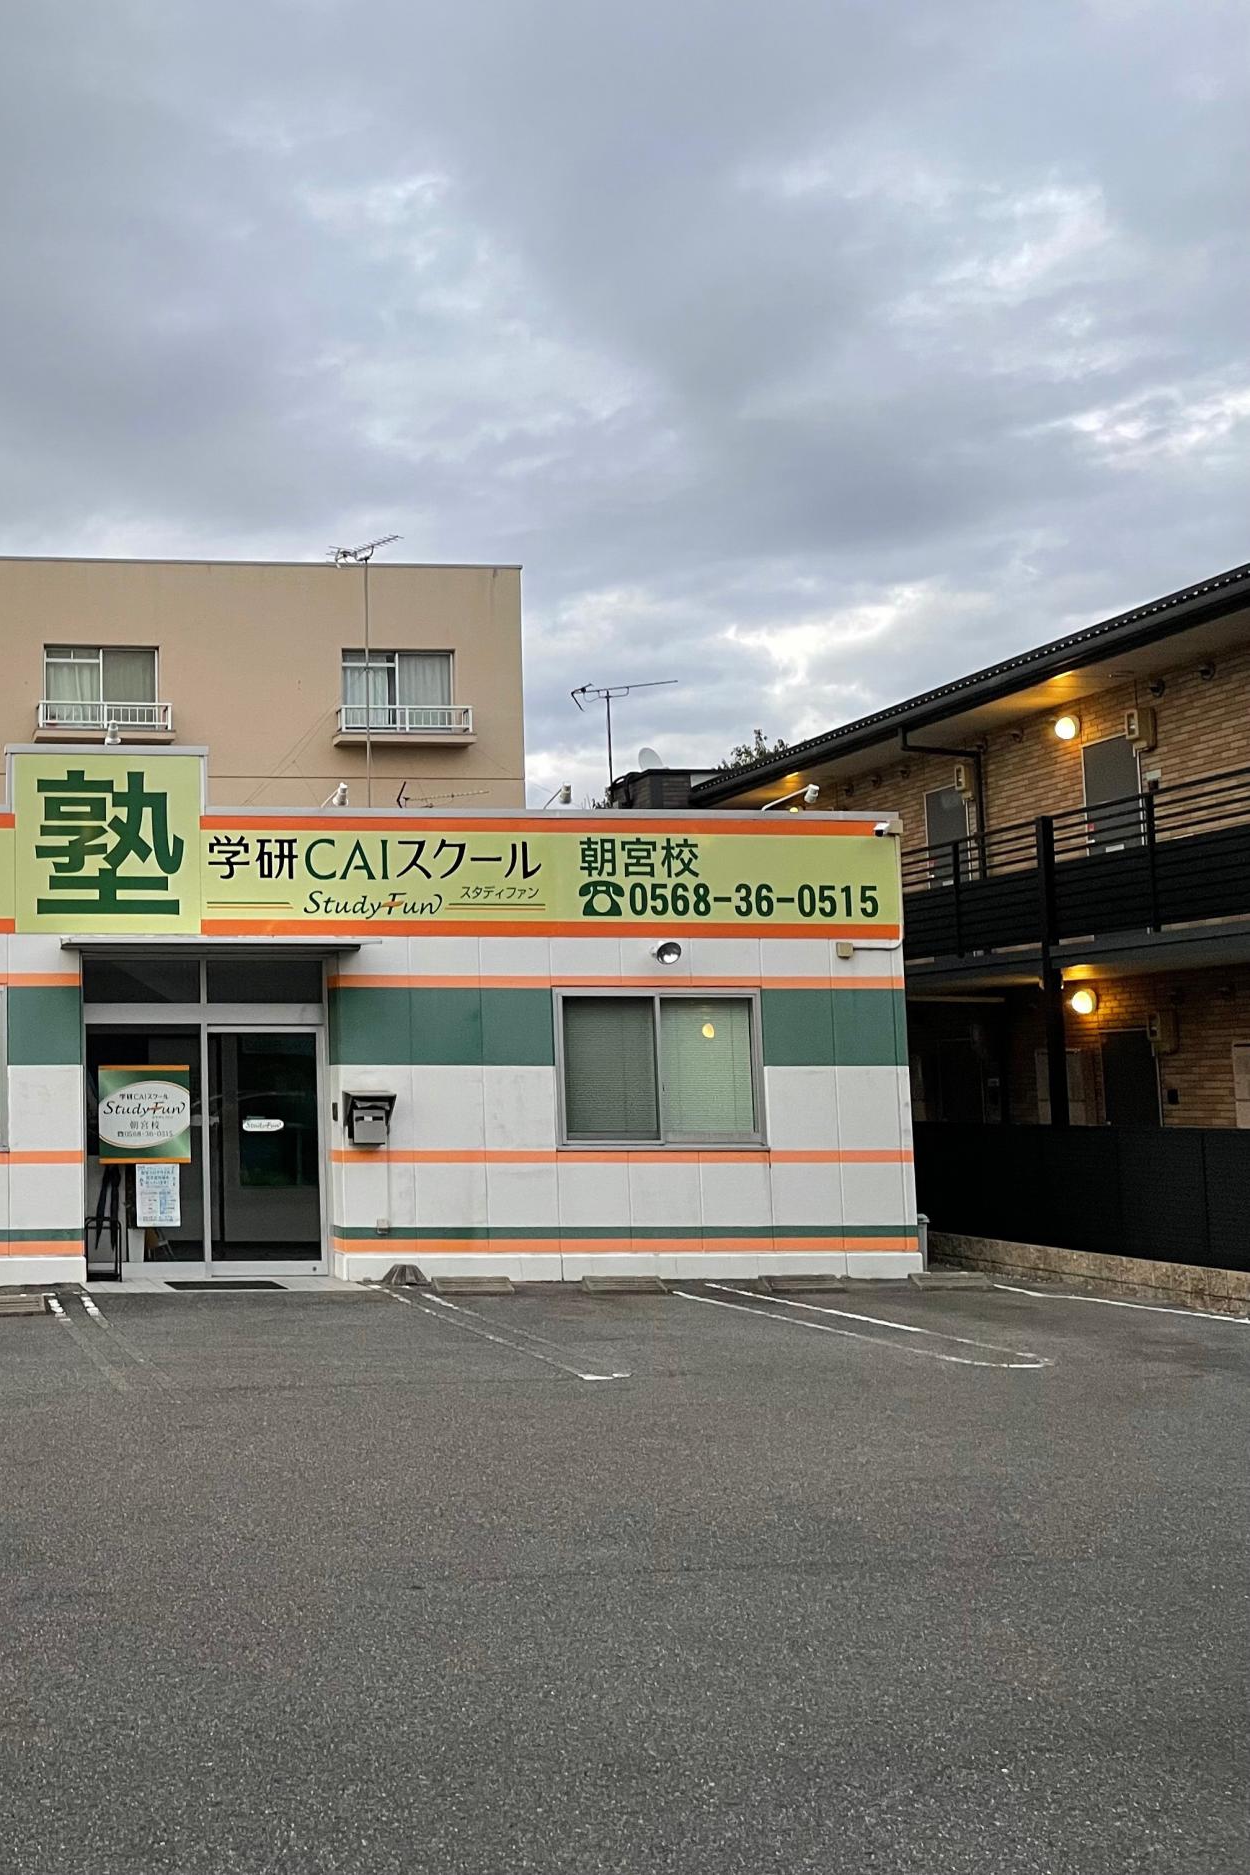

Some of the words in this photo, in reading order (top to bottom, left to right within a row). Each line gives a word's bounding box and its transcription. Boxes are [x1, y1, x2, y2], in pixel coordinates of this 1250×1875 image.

[34, 771, 185, 915] 塾
[207, 835, 543, 880] 学研CAIスクール
[579, 837, 700, 878] 朝宮校
[460, 886, 540, 899] スタディファン
[629, 882, 879, 917] 0568-36-0515
